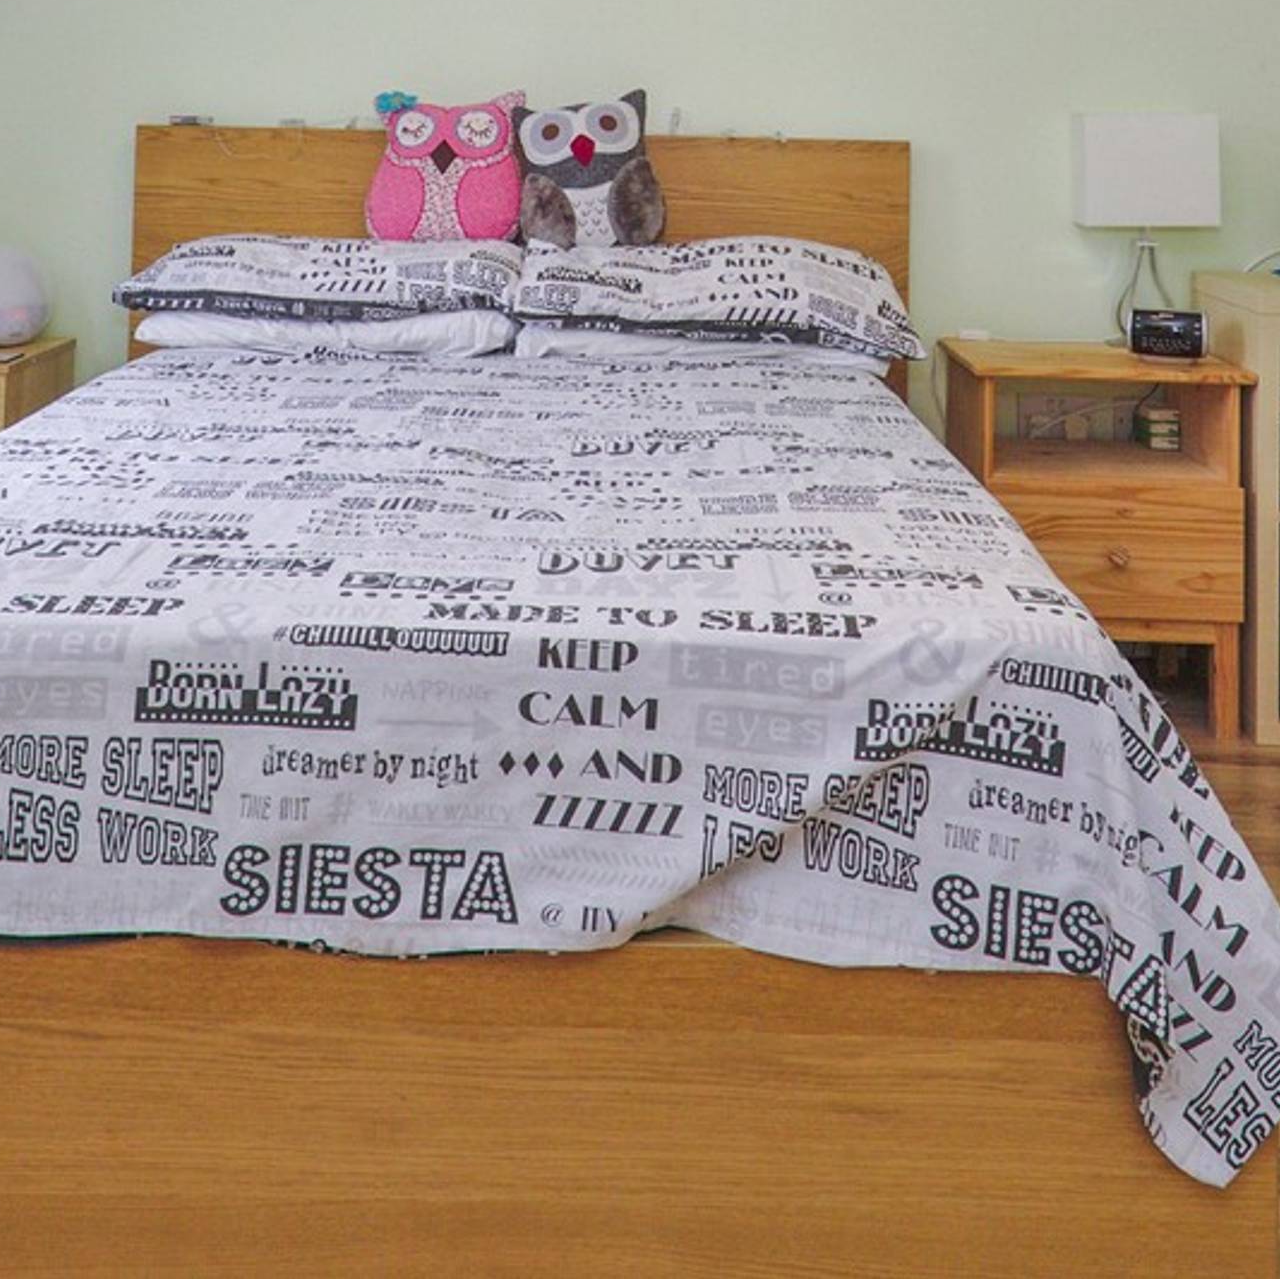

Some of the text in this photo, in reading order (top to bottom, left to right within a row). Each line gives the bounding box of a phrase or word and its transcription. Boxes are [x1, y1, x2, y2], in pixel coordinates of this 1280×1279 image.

[751, 288, 799, 302] AND
[537, 552, 740, 575] DUVET
[1, 595, 184, 616] SLEEP
[424, 602, 878, 639] MADE TO SLEEP
[537, 636, 639, 672] KEEP
[679, 650, 839, 693] tired
[147, 659, 244, 714] BORN
[518, 689, 659, 731] CALM
[102, 737, 226, 814] SLEEP
[262, 743, 481, 789] dreamer by night
[579, 749, 683, 785] AND
[702, 763, 809, 822] MORE
[968, 778, 1074, 825] dreamer
[98, 808, 220, 867] WORK
[802, 817, 921, 892] WORK
[220, 842, 519, 924] SIESTA
[1158, 930, 1237, 1013] AND
